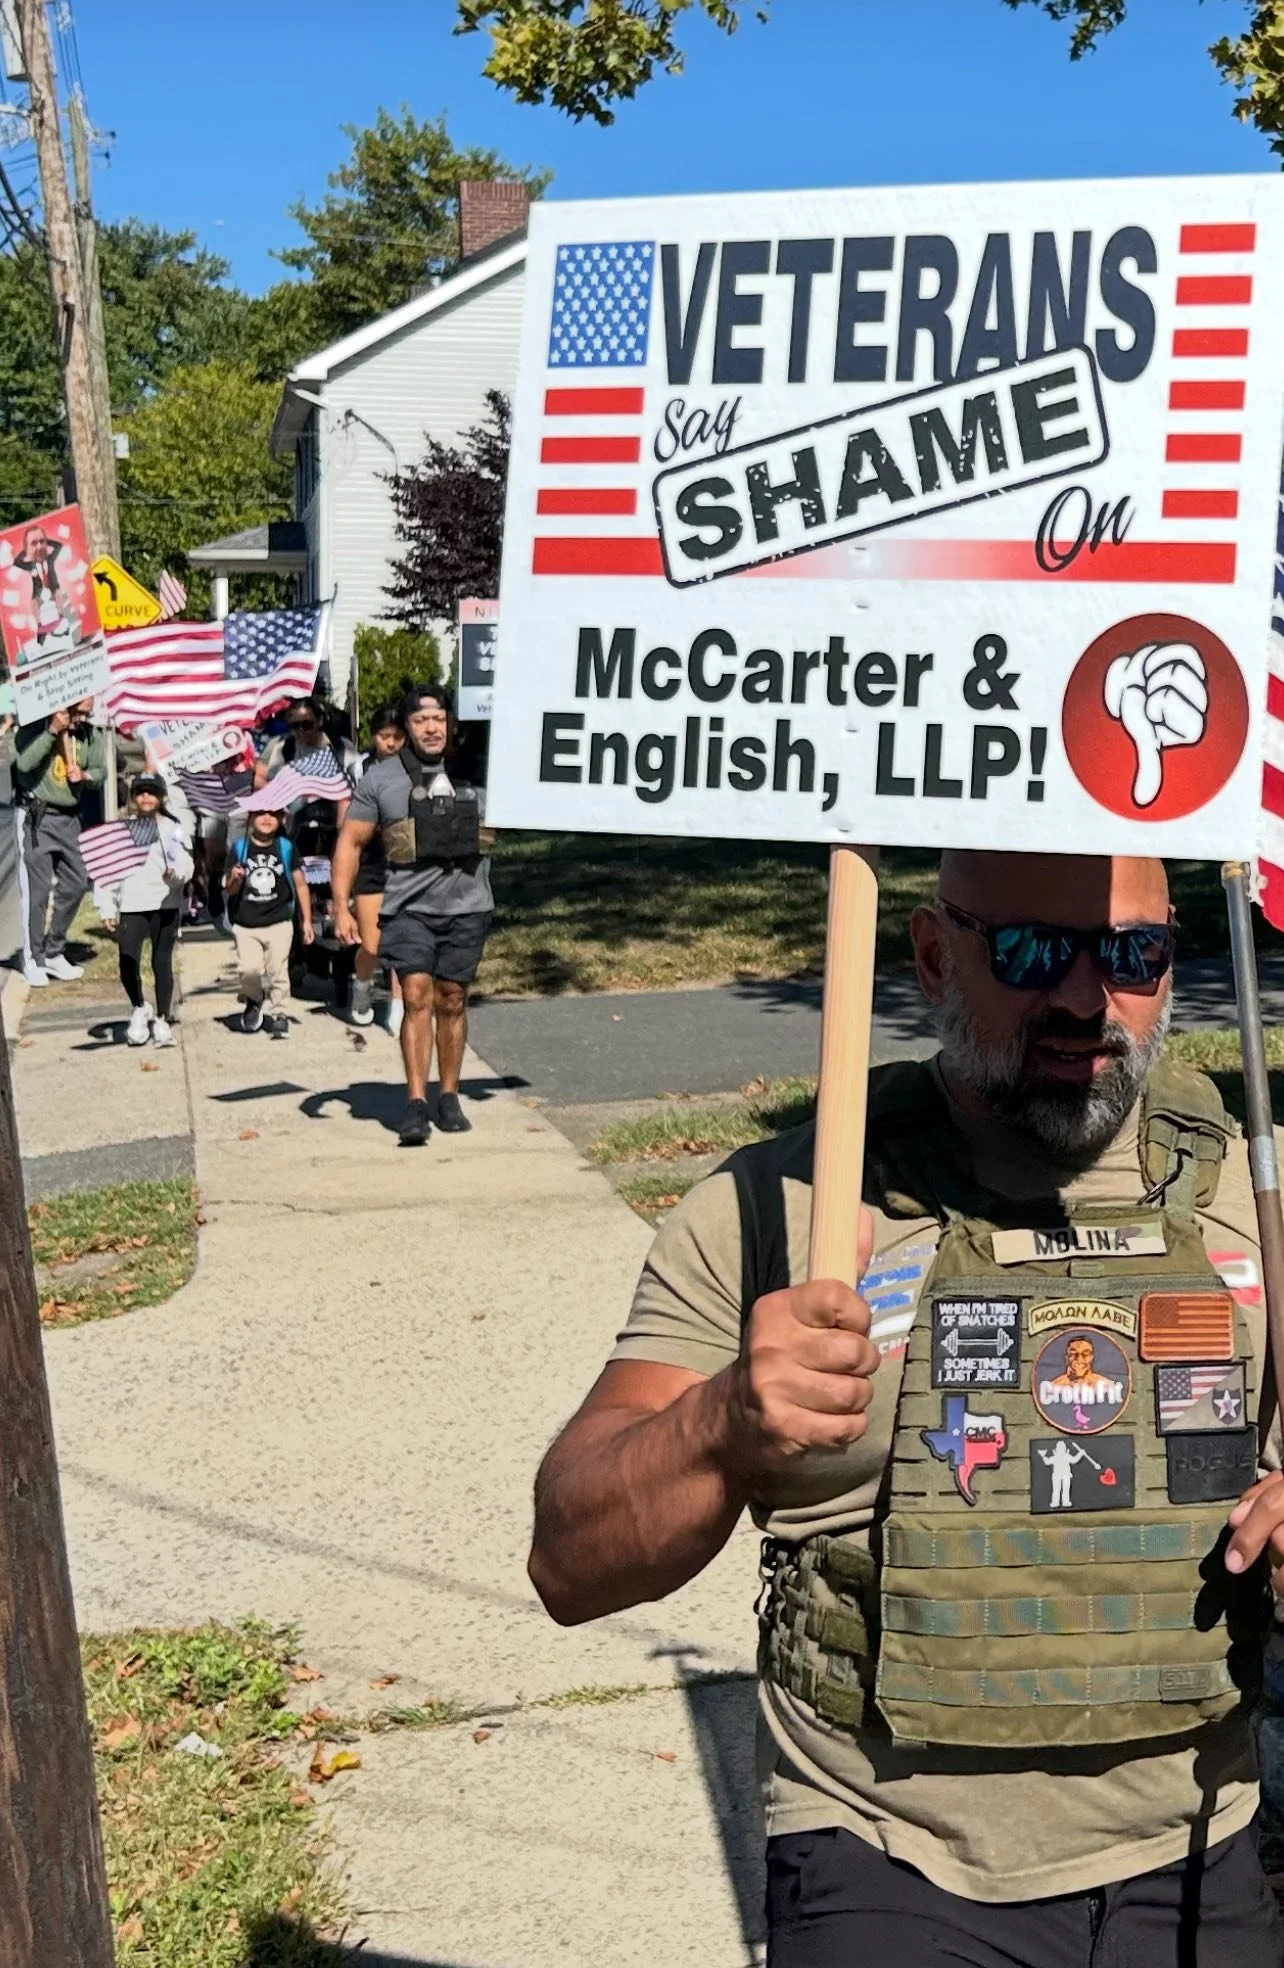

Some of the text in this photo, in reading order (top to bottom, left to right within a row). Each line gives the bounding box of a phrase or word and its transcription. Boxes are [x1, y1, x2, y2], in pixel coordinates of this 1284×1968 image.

[661, 226, 1158, 385] VETERANS
[654, 396, 742, 463] Say
[676, 366, 1091, 562] SHAME
[1035, 486, 1137, 573] On
[105, 604, 150, 617] CURVE
[575, 627, 1021, 710] McCarter &
[539, 712, 1048, 812] English, LLP!
[1034, 1227, 1130, 1255] MOLINA
[939, 1303, 1018, 1315] WHEN I'M TIRED
[941, 1314, 1015, 1327] OF SNATCHES
[938, 1369, 1016, 1382] I JUST JERK IT
[943, 1357, 1010, 1369] SOMETIMES
